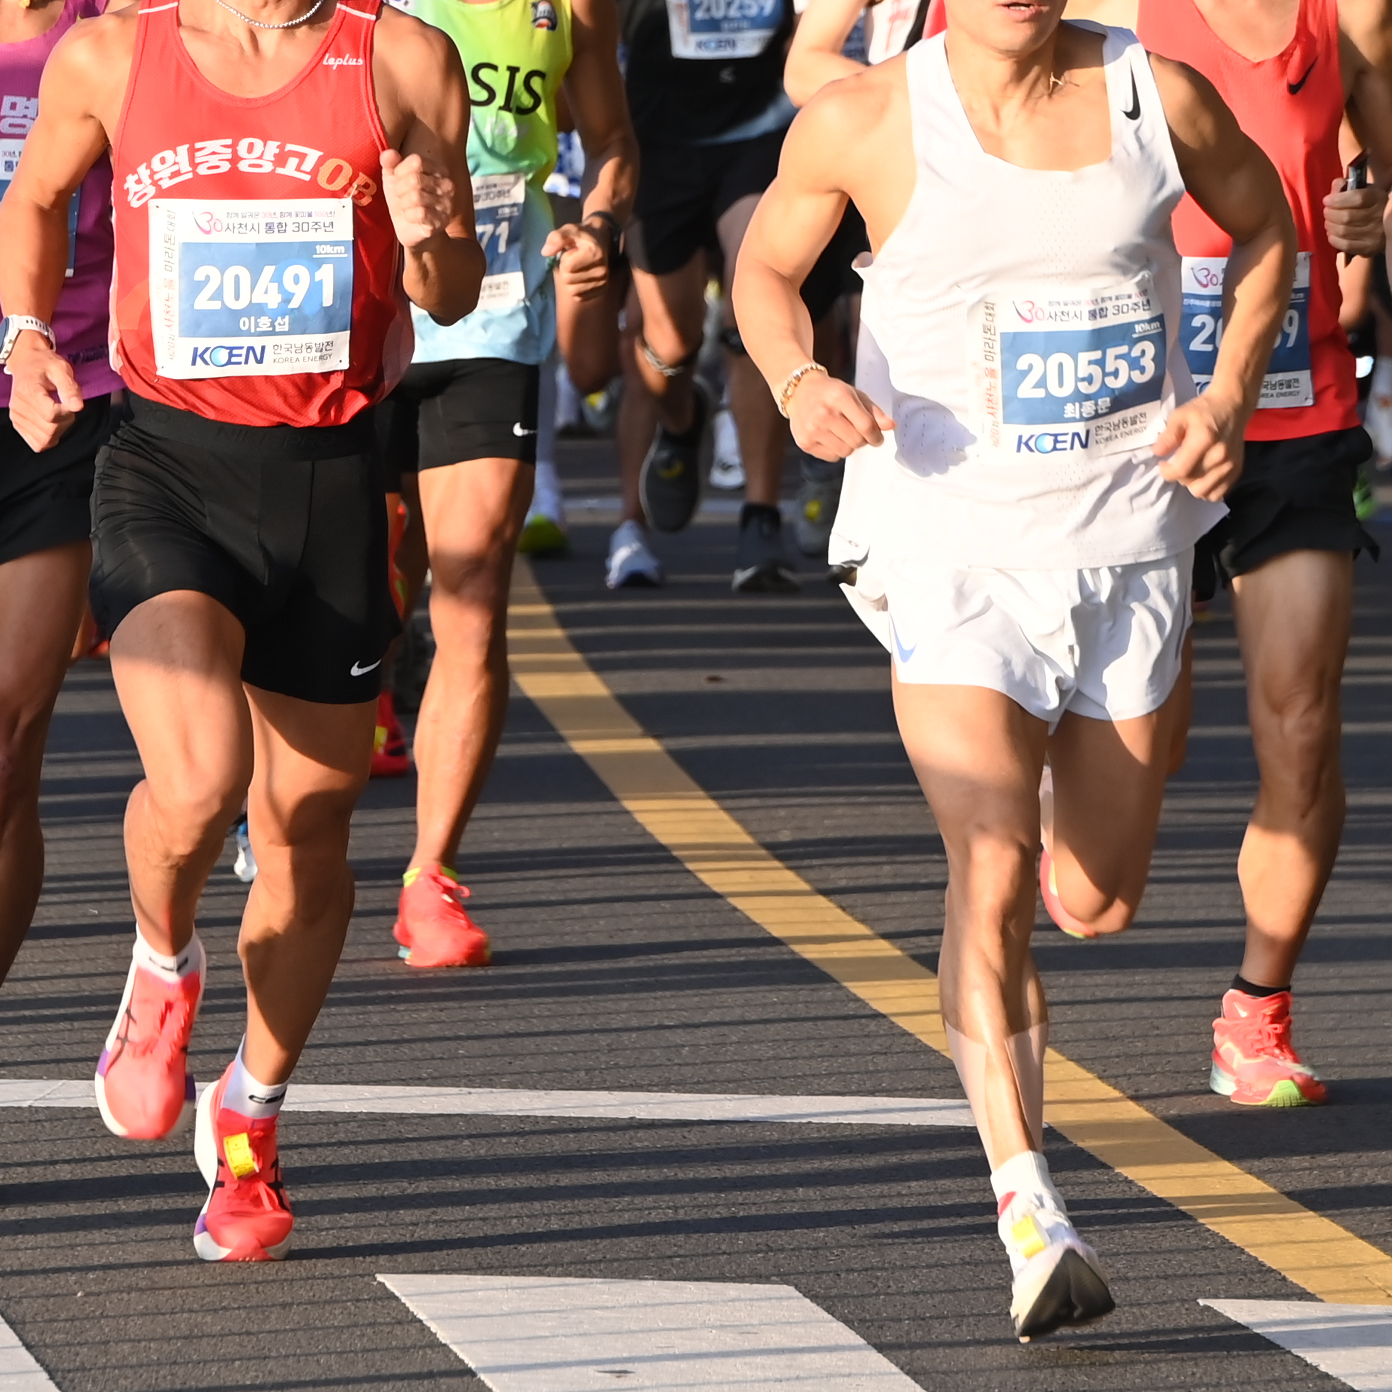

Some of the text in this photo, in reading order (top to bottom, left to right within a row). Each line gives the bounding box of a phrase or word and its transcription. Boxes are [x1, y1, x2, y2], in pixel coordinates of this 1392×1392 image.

[322, 53, 364, 70] leplus
[470, 62, 547, 116] SIS
[224, 221, 335, 234] 사천시 통합 30주년
[315, 244, 345, 255] 10km
[193, 264, 335, 311] 20491
[1112, 298, 1152, 316] 30주년
[239, 315, 290, 334] 이호섭
[190, 344, 267, 368] KOEN
[272, 340, 335, 355] 한국남동발전
[272, 356, 301, 364] KOREA
[1016, 340, 1156, 399] 20553
[1261, 377, 1300, 391] 국남동발전
[1016, 429, 1090, 454] KOEN
